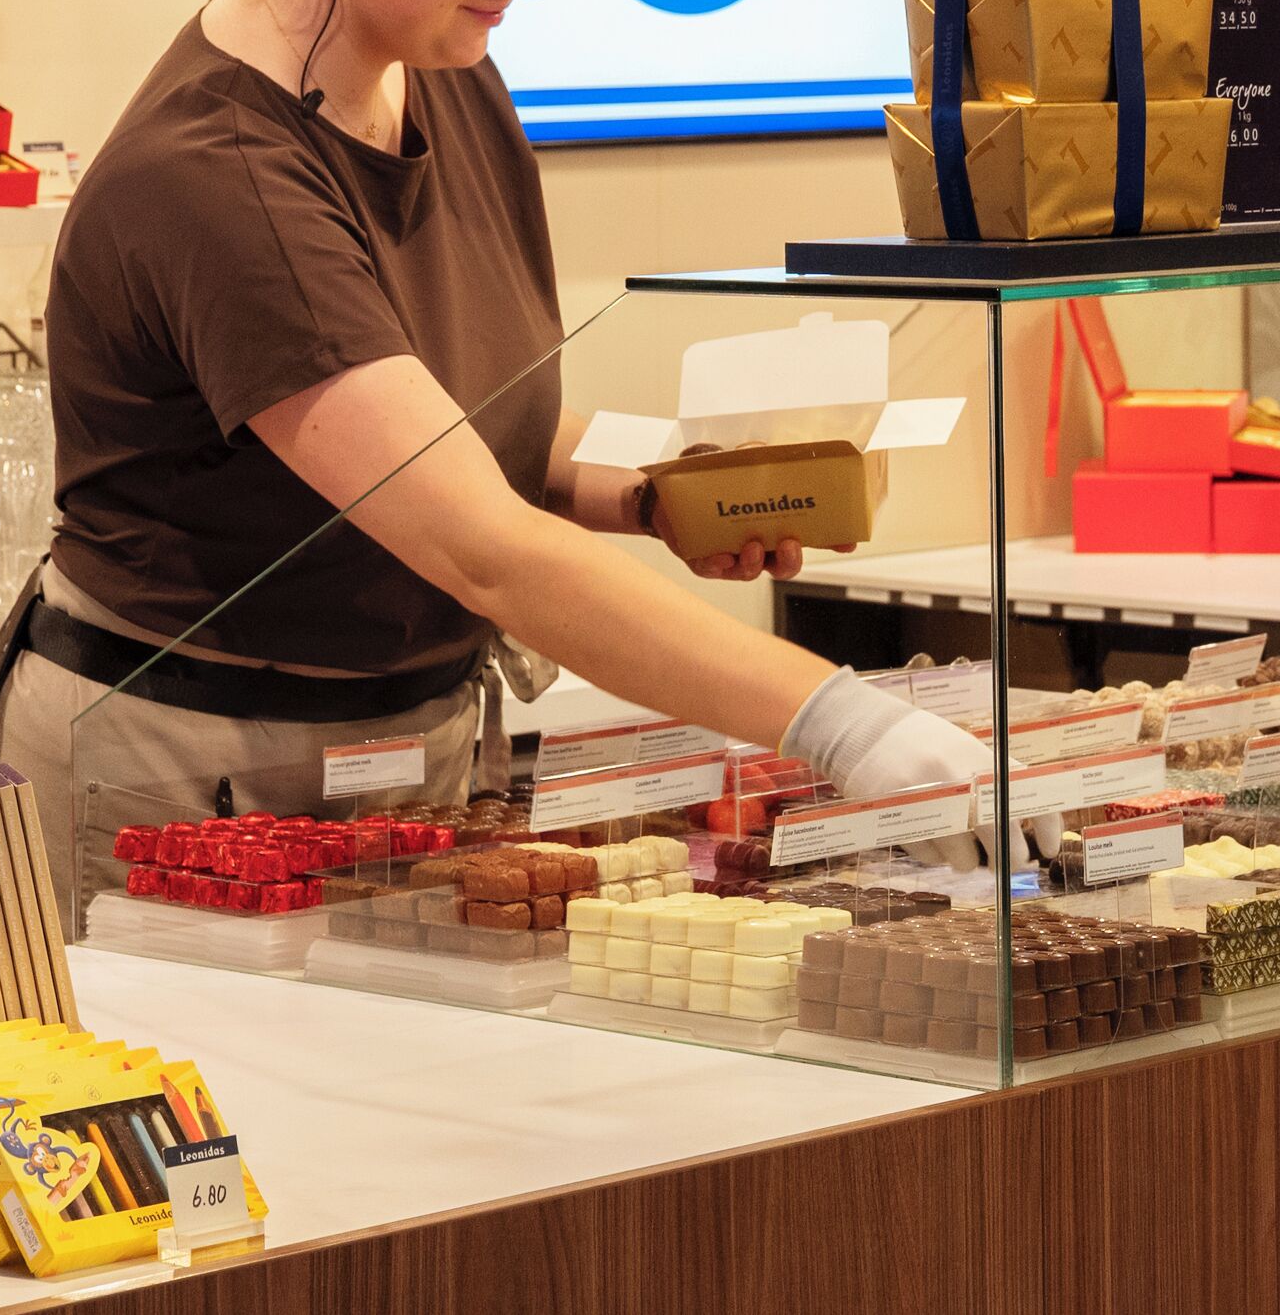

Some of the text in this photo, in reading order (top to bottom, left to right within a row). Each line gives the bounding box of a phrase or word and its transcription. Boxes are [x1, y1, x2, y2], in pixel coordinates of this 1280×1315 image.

[1215, 77, 1271, 110] Everyone
[1243, 111, 1252, 123] kg
[716, 493, 816, 517] Leonidas
[1088, 843, 1102, 851] Louise
[180, 1146, 225, 1162] Leonidas
[192, 1185, 227, 1208] 6.80
